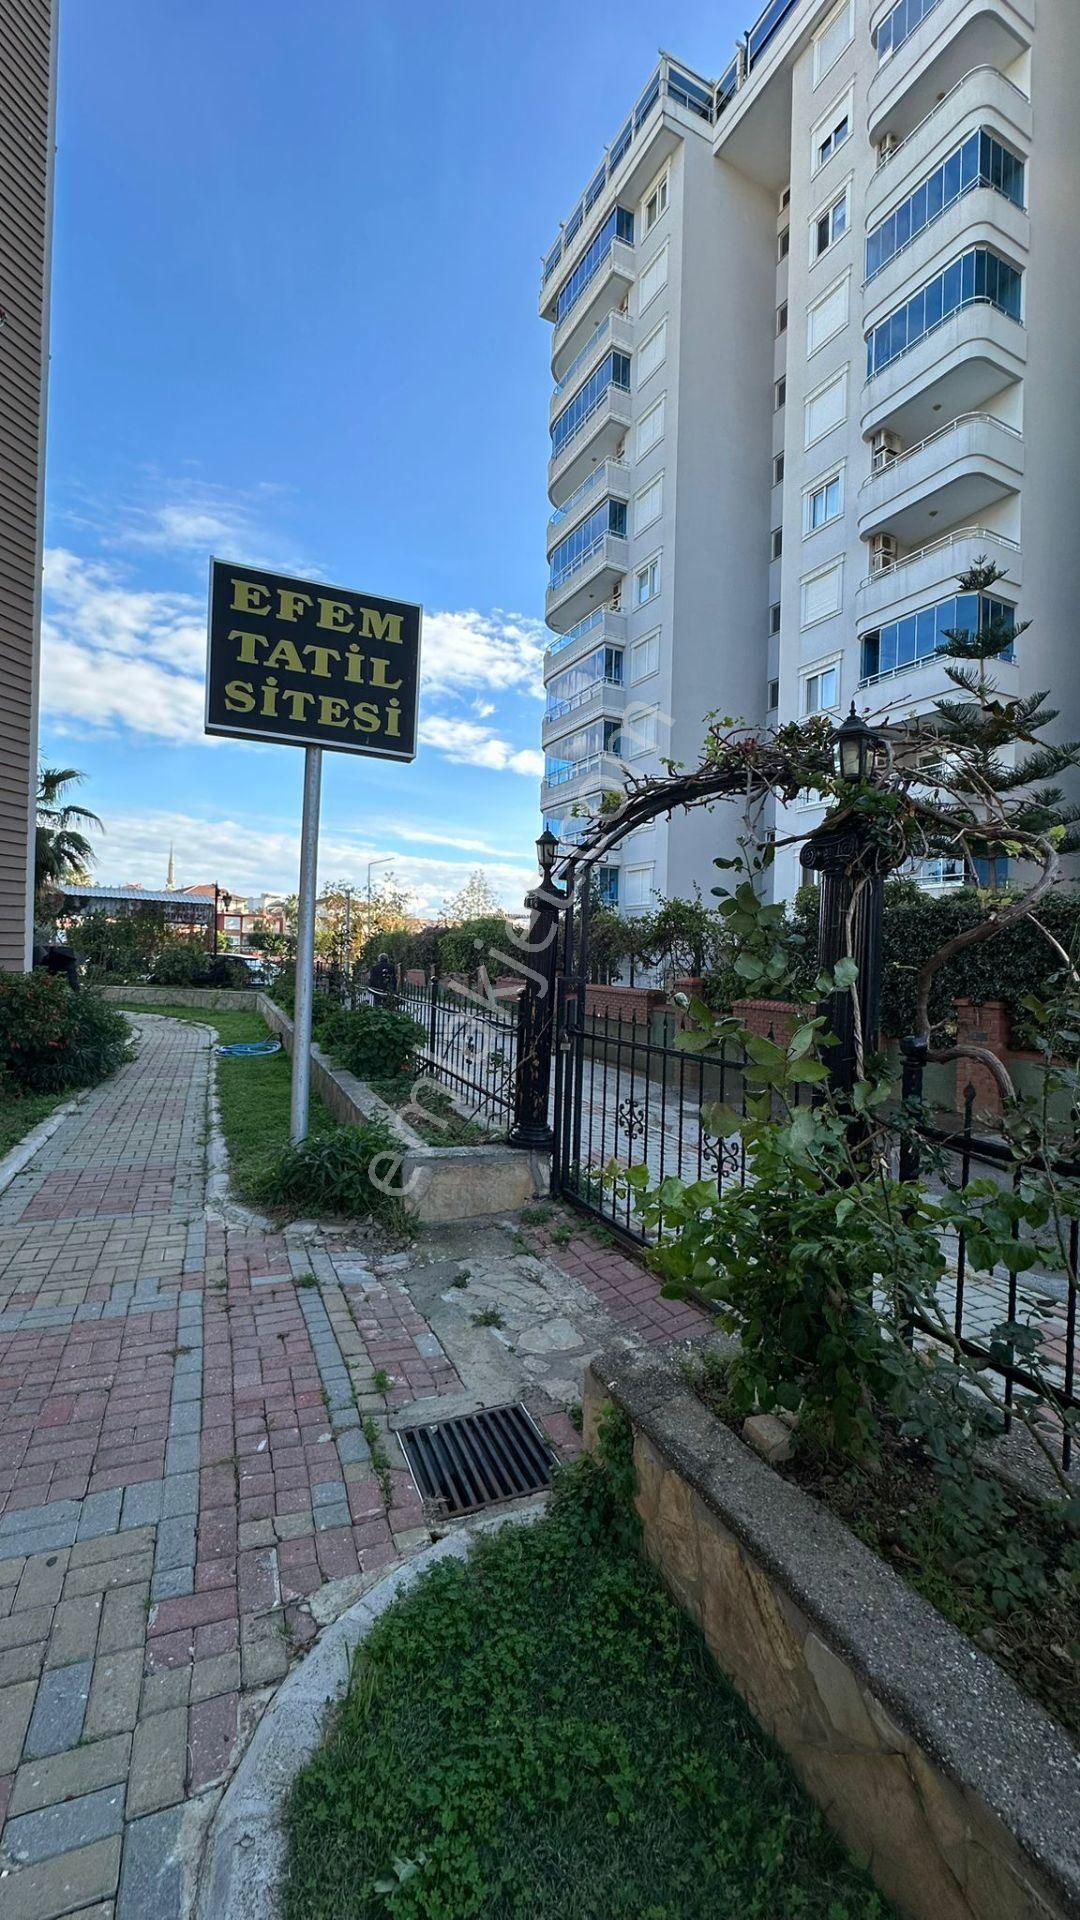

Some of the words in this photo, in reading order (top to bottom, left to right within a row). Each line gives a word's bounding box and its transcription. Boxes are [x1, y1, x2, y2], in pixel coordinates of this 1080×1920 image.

[230, 579, 404, 644] EFEM
[227, 630, 403, 690] TATİL
[224, 676, 401, 737] SİTESİ
